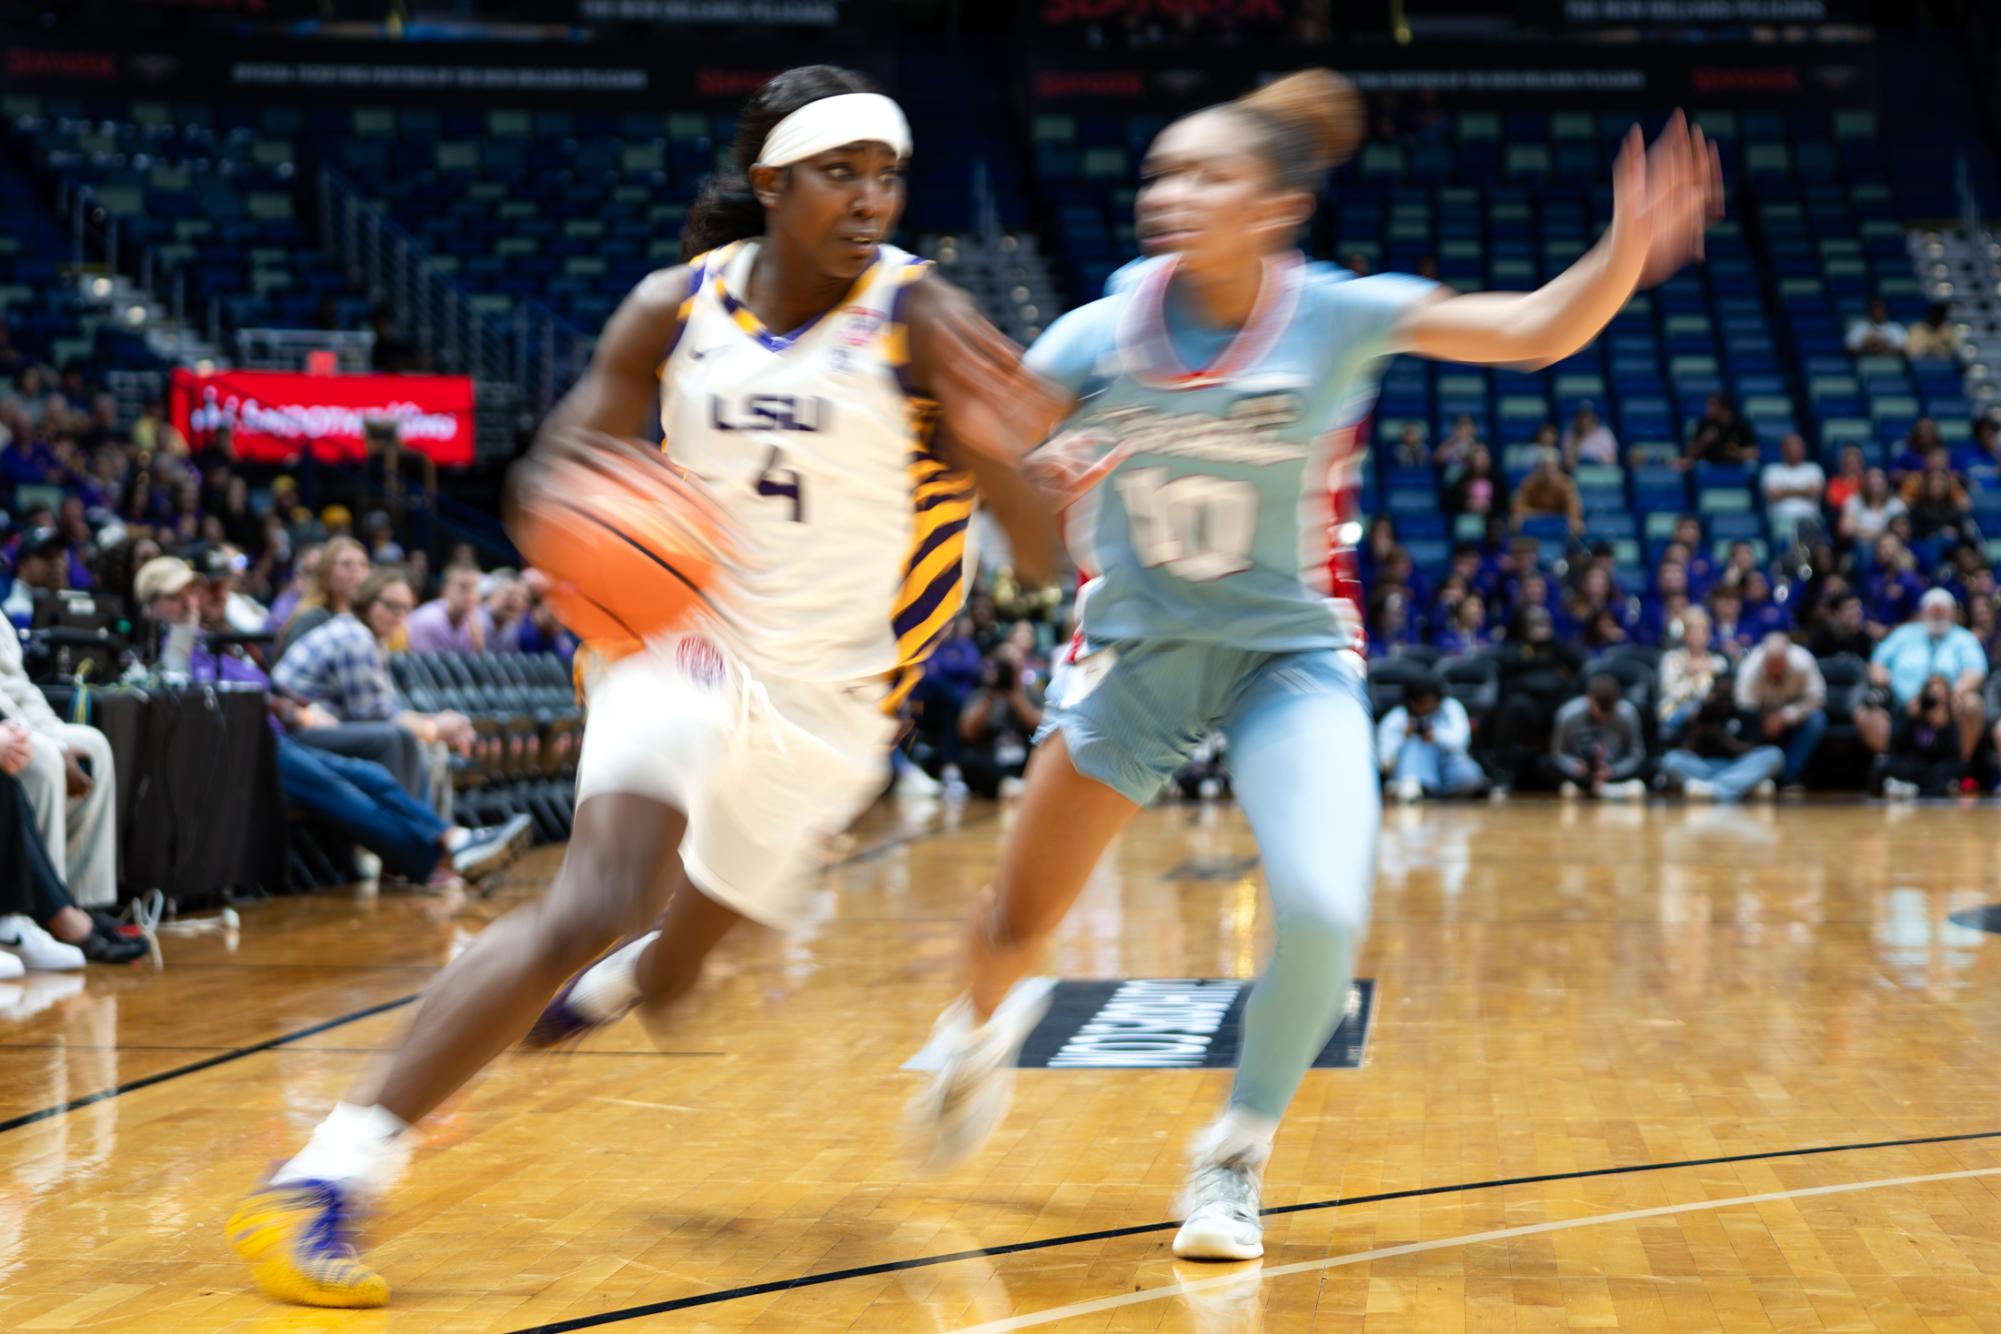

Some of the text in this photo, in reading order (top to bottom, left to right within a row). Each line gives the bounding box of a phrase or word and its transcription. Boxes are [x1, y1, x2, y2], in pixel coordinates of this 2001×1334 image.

[708, 393, 830, 433] LSU
[756, 444, 808, 522] 4
[1116, 468, 1258, 581] 10
